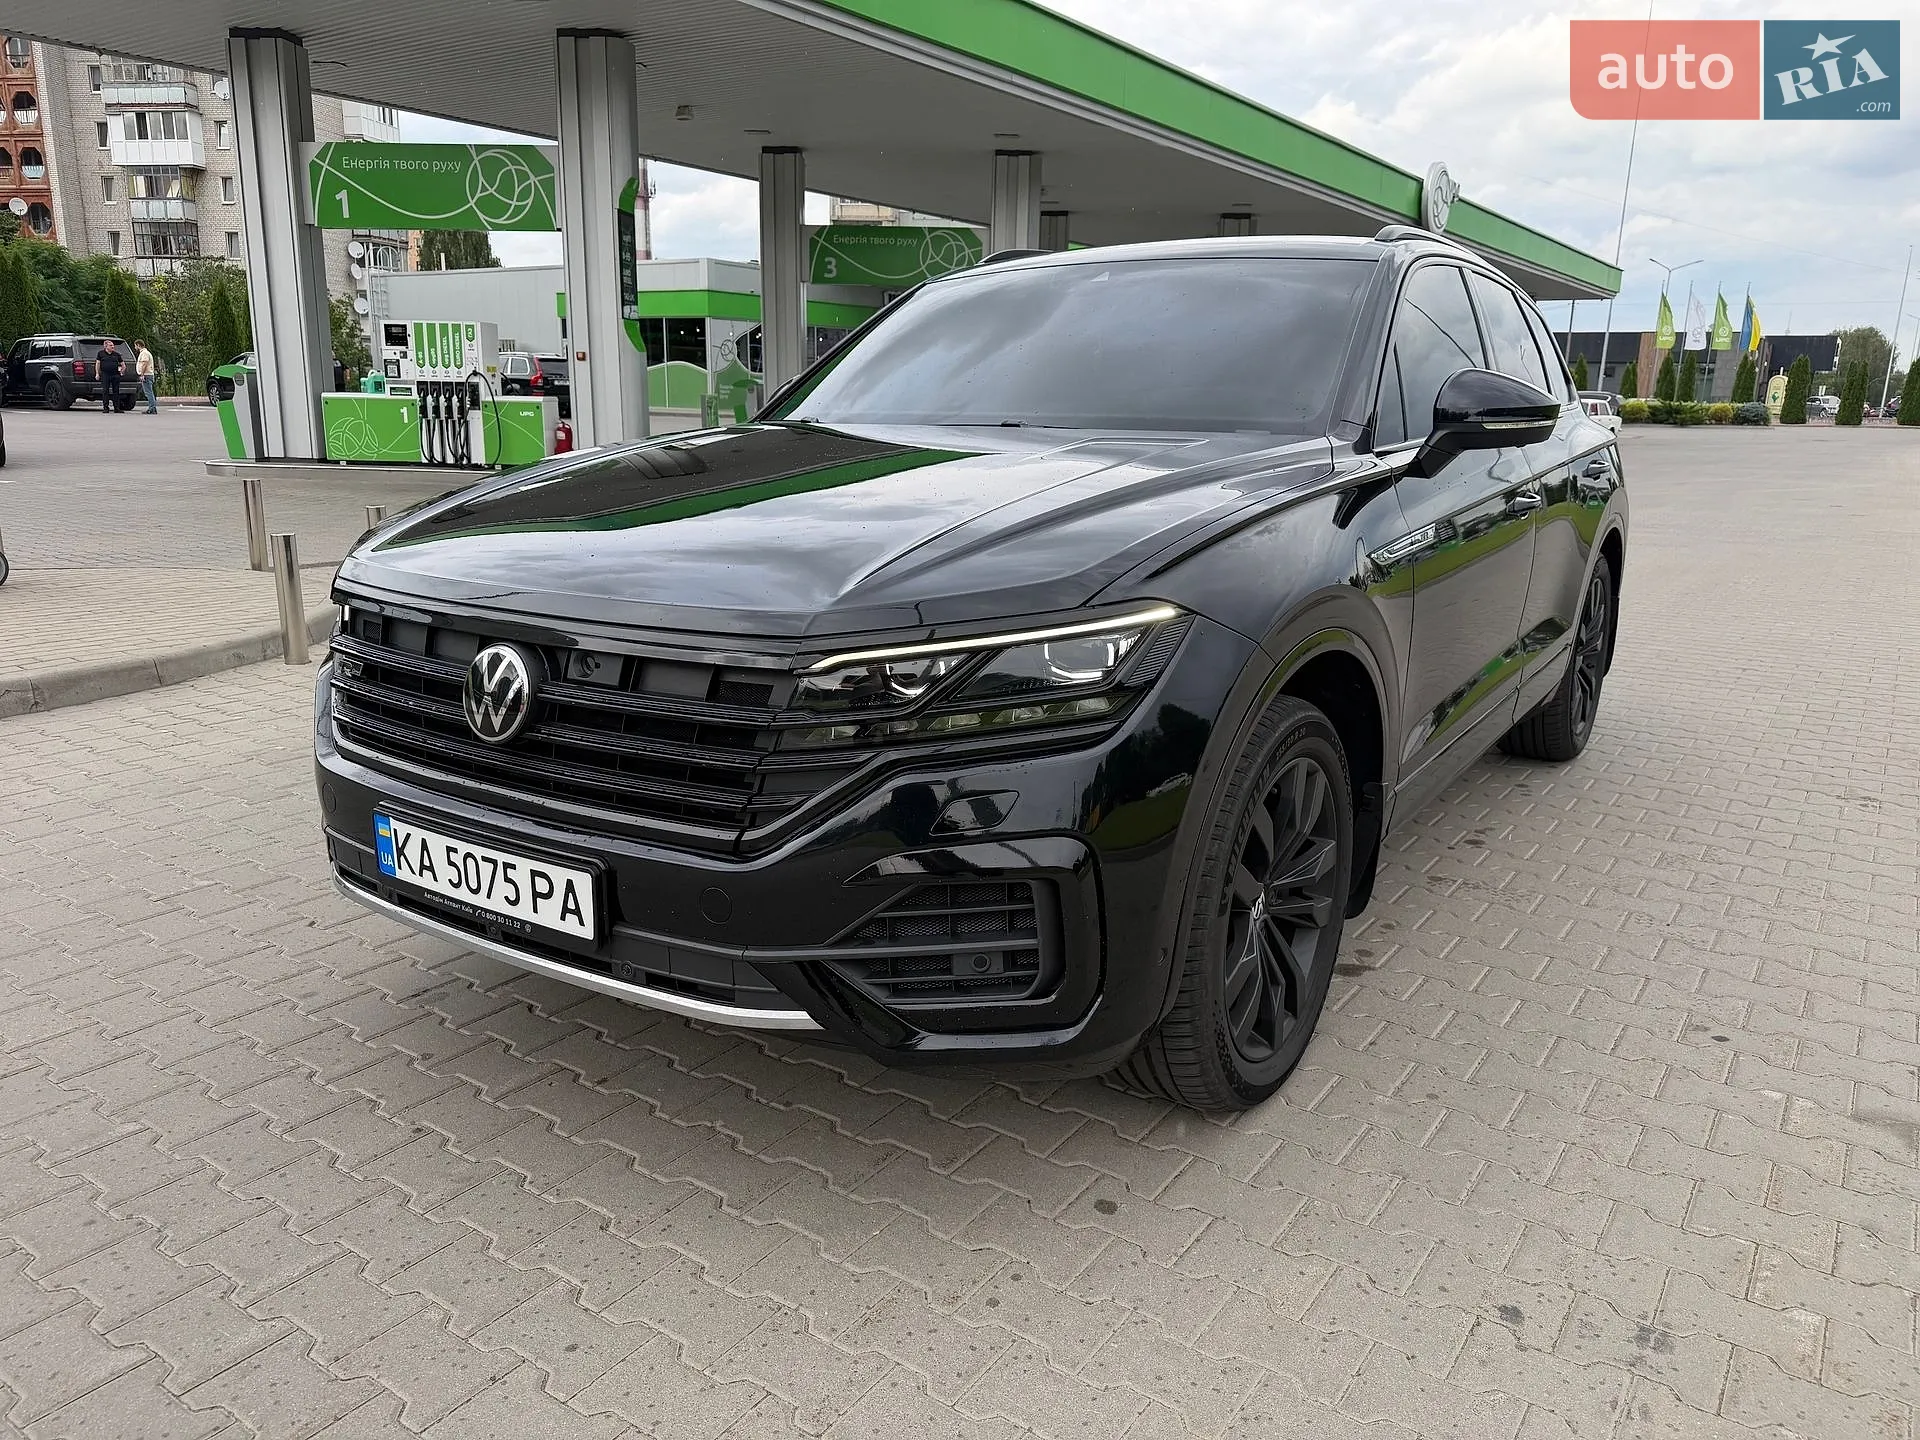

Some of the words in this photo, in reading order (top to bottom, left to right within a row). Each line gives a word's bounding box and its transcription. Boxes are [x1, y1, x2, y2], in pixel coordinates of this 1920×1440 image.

[342, 156, 390, 171] Енергія
[393, 159, 429, 170] твого
[433, 160, 462, 173] руху
[335, 189, 350, 219] 1
[833, 234, 868, 245] Енергія
[869, 237, 895, 245] твого
[897, 237, 918, 248] руху
[823, 256, 837, 279] 3
[400, 406, 408, 424] 1
[381, 852, 394, 868] UA
[394, 828, 438, 883] KA
[445, 845, 521, 907] 5075
[529, 868, 585, 927] PA
[486, 913, 497, 921] 800
[497, 915, 504, 924] 30
[505, 918, 512, 926] 11
[513, 920, 521, 929] 22
